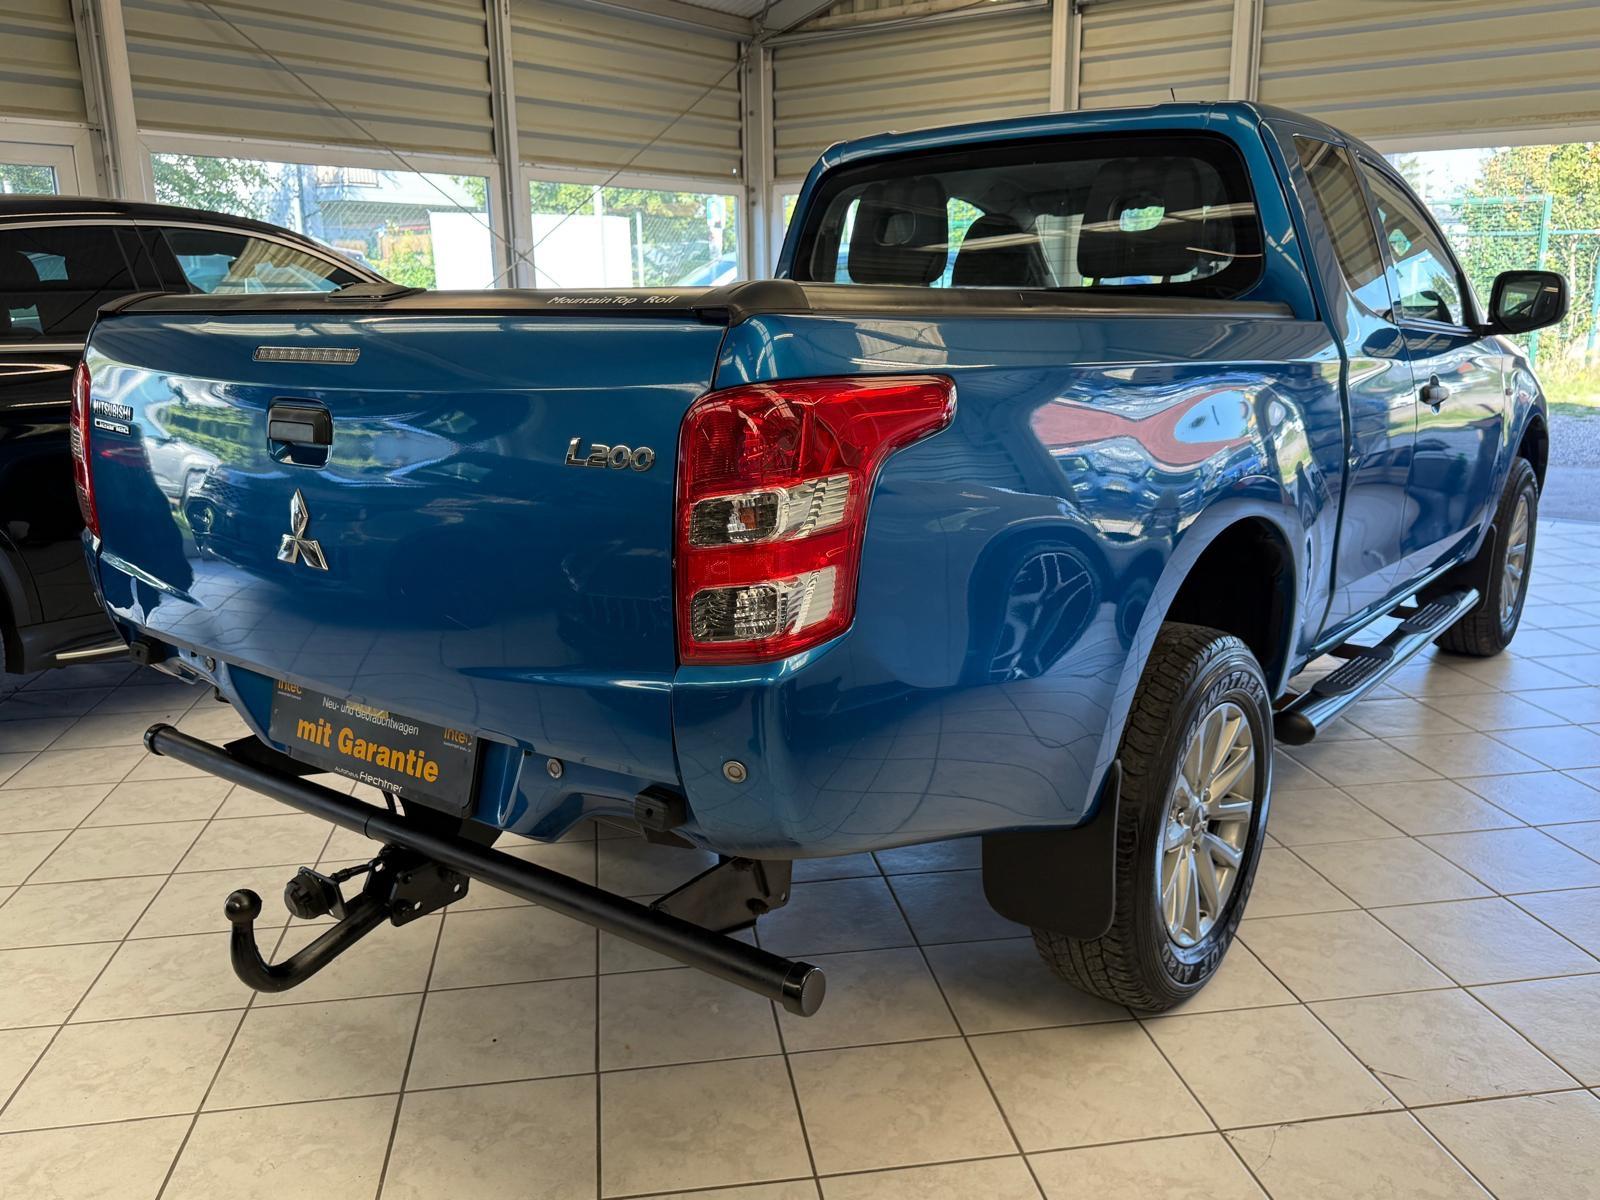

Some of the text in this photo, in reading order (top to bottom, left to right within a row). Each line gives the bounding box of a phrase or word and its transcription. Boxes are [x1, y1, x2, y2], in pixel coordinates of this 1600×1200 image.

[643, 295, 679, 304] Roll
[93, 400, 131, 420] MITSUBISHI
[565, 437, 655, 472] L200
[322, 696, 340, 710] Neu-
[296, 718, 440, 783] mit Garantie
